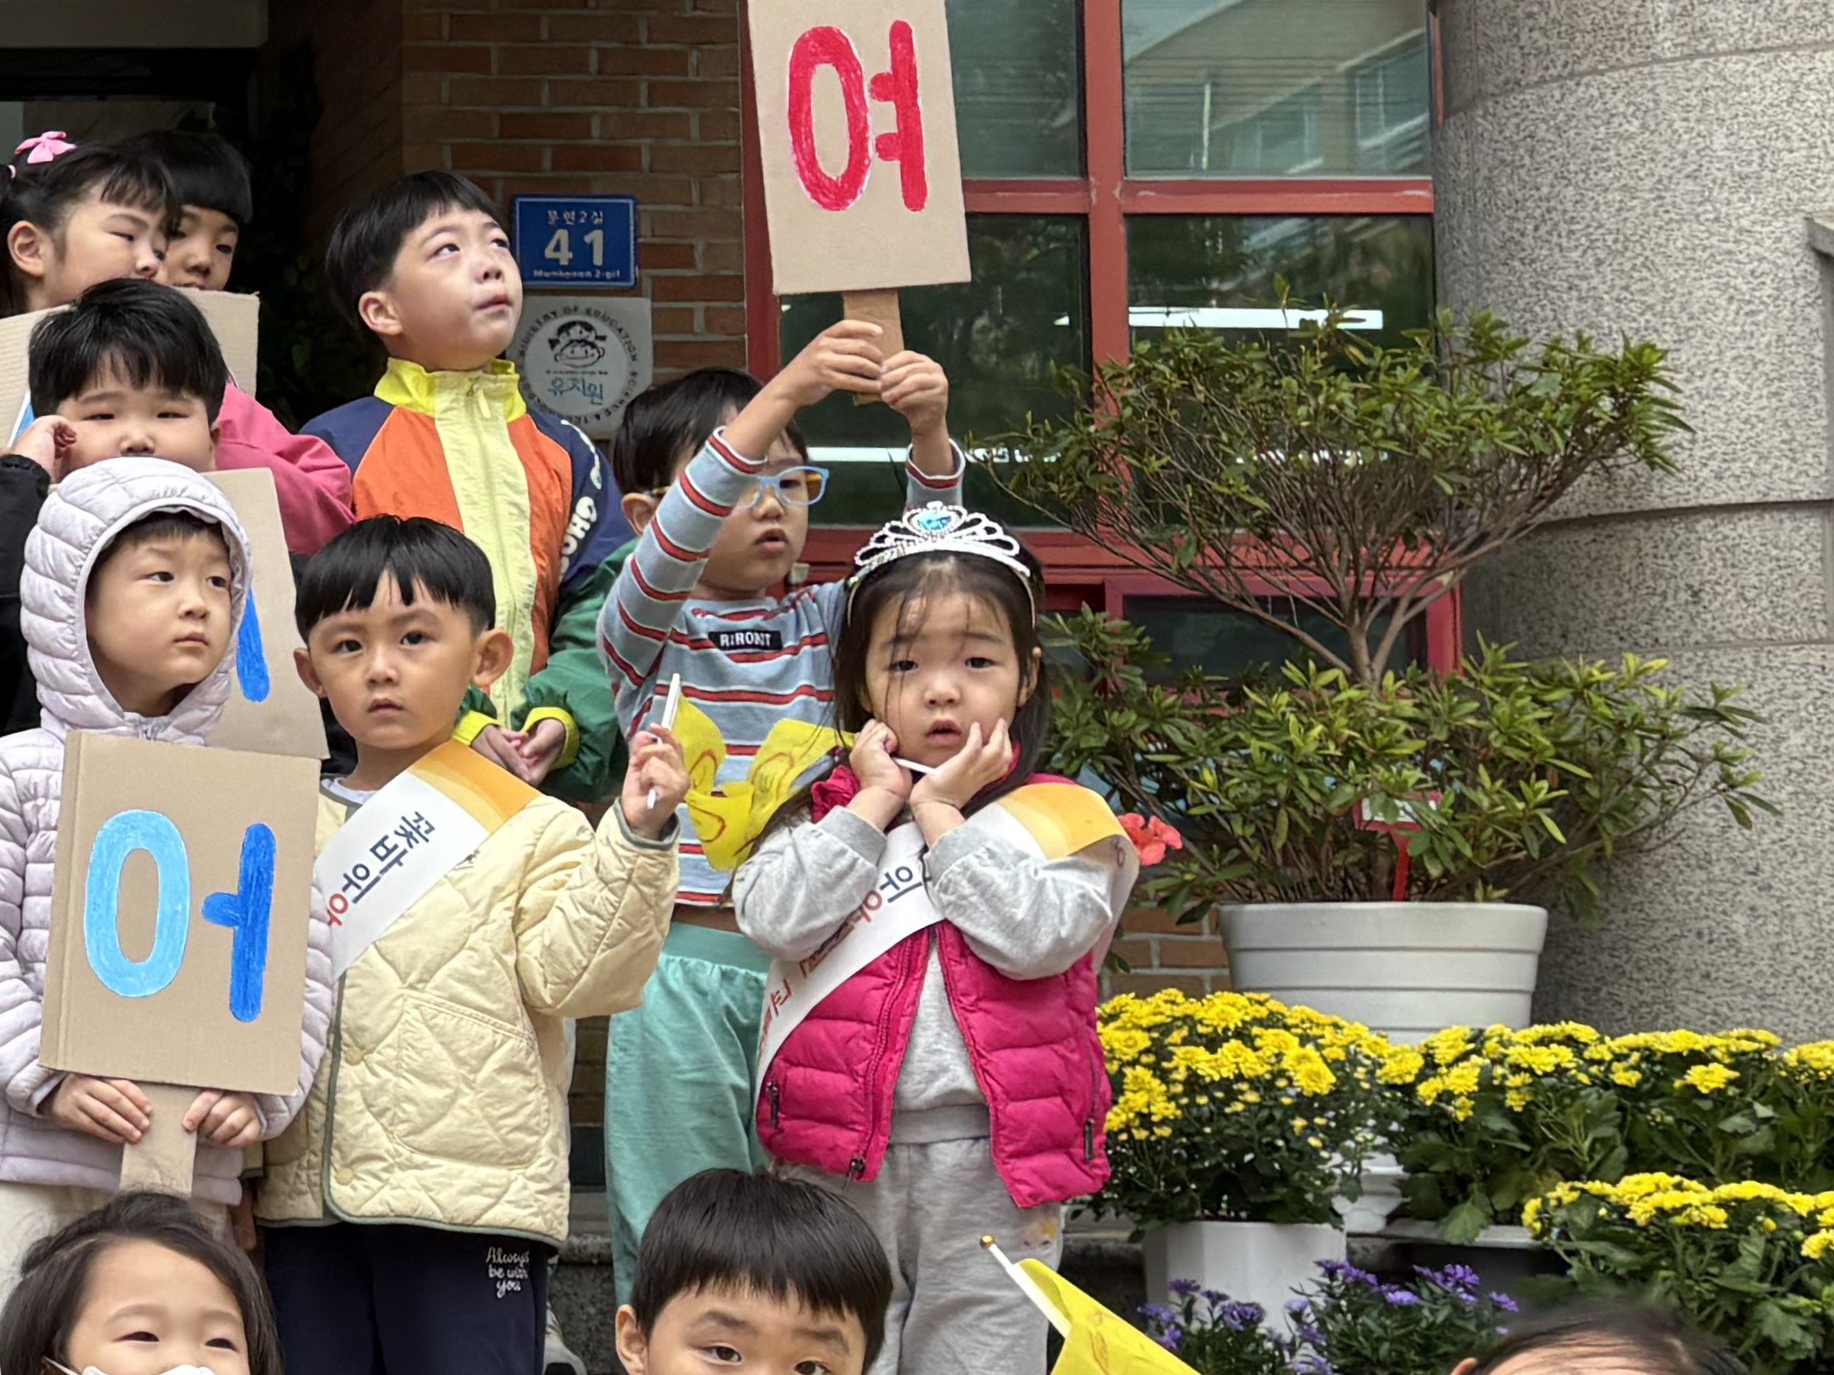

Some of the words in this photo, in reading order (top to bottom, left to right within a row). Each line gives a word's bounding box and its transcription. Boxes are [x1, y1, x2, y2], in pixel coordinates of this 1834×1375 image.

[787, 18, 929, 213] 여
[543, 228, 605, 268] 41
[547, 376, 604, 407] 유치원
[84, 808, 277, 1024] 어
[485, 1246, 530, 1268] Always
[488, 1263, 505, 1279] be
[496, 1279, 522, 1299] you
